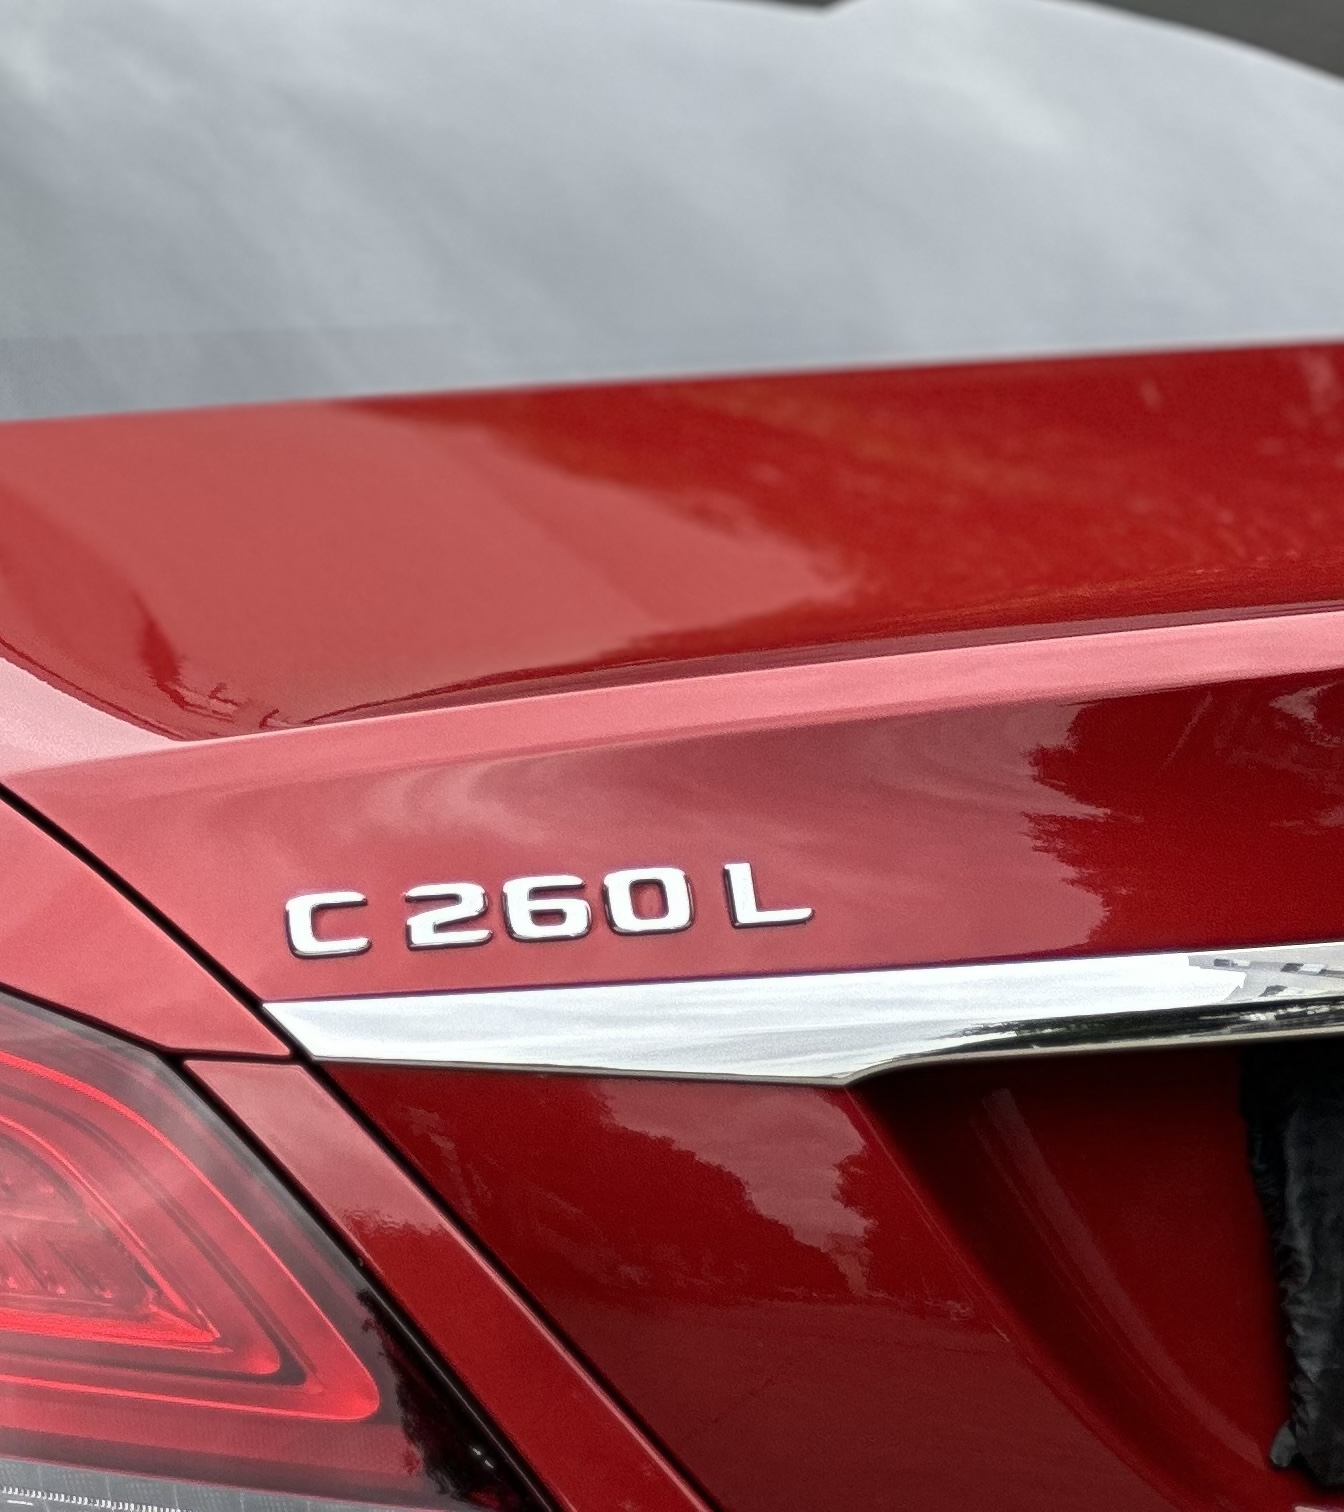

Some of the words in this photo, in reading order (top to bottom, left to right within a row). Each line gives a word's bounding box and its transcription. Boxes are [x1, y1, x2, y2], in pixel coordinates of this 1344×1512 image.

[284, 890, 372, 959] C
[404, 866, 696, 950] 260
[721, 861, 814, 928] L
